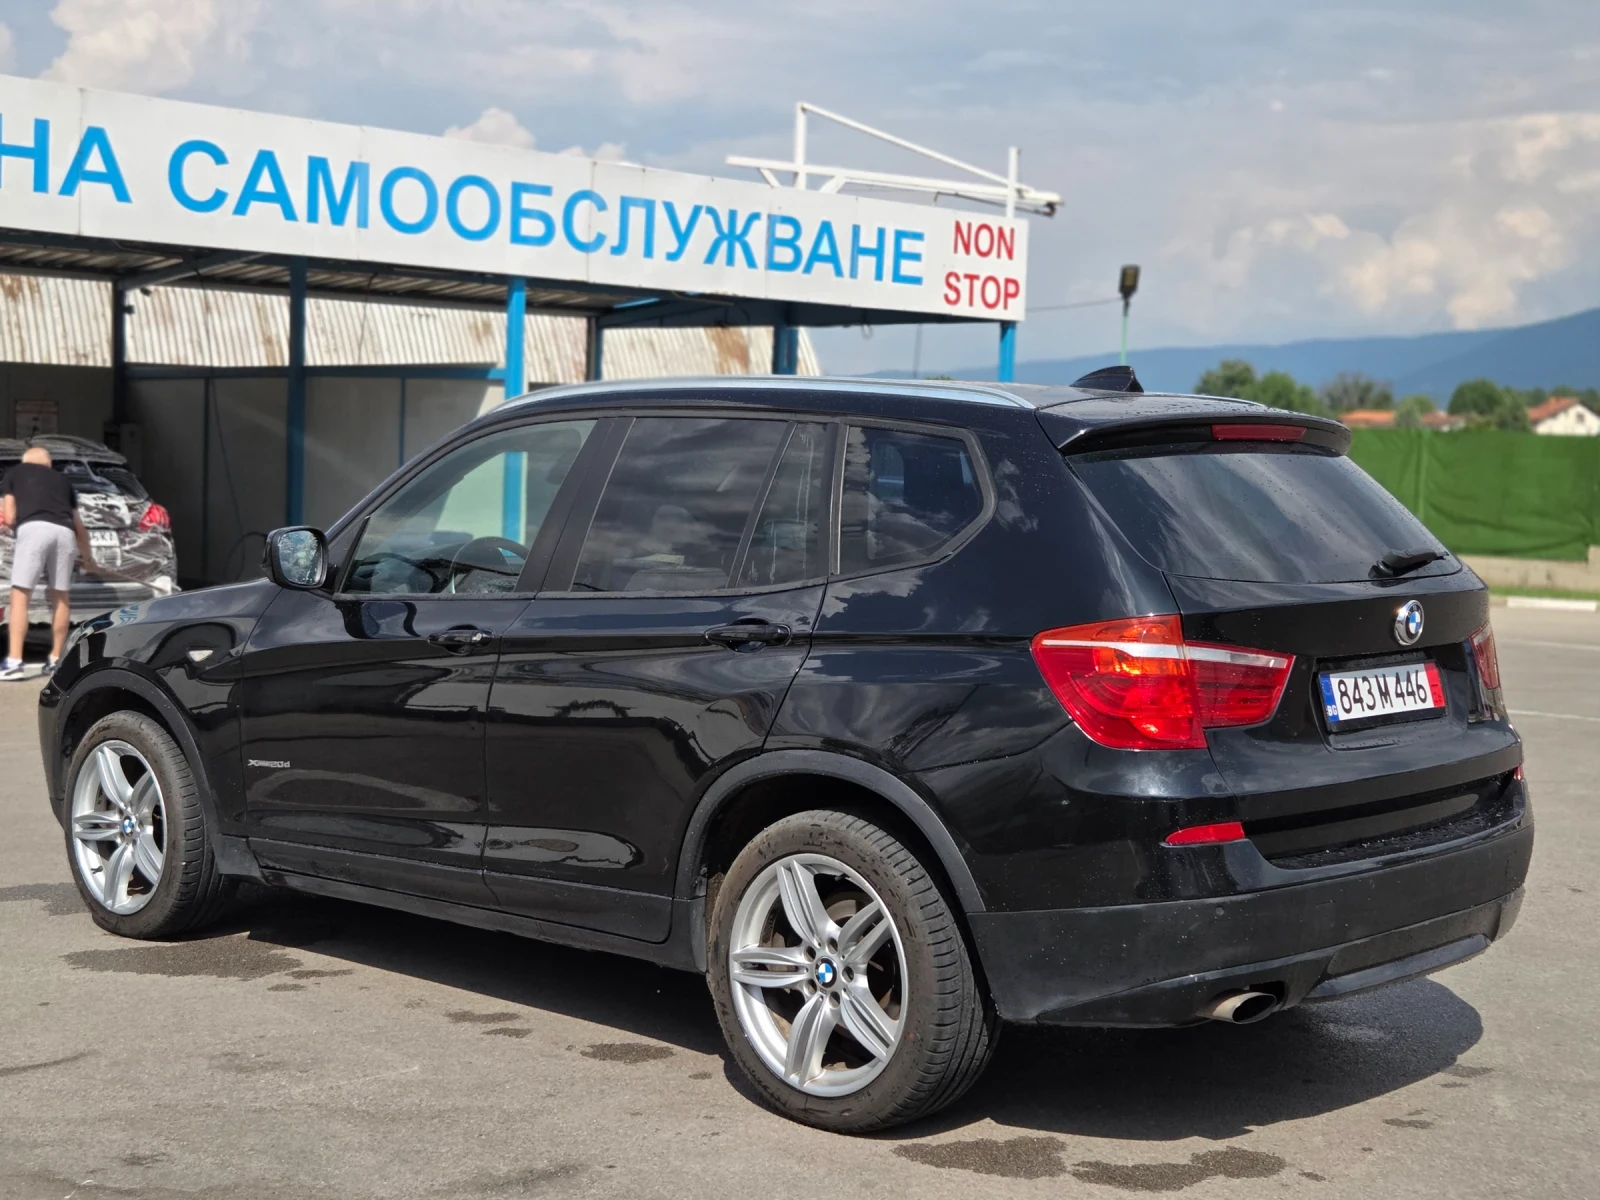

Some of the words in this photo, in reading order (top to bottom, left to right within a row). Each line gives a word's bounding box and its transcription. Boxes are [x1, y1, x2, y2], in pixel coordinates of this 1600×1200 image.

[0, 112, 132, 203] НА
[168, 139, 925, 285] САМООБСЛУЖВАНЕ
[953, 220, 1015, 260] NON
[943, 270, 1020, 309] STOP
[1327, 704, 1338, 716] BG
